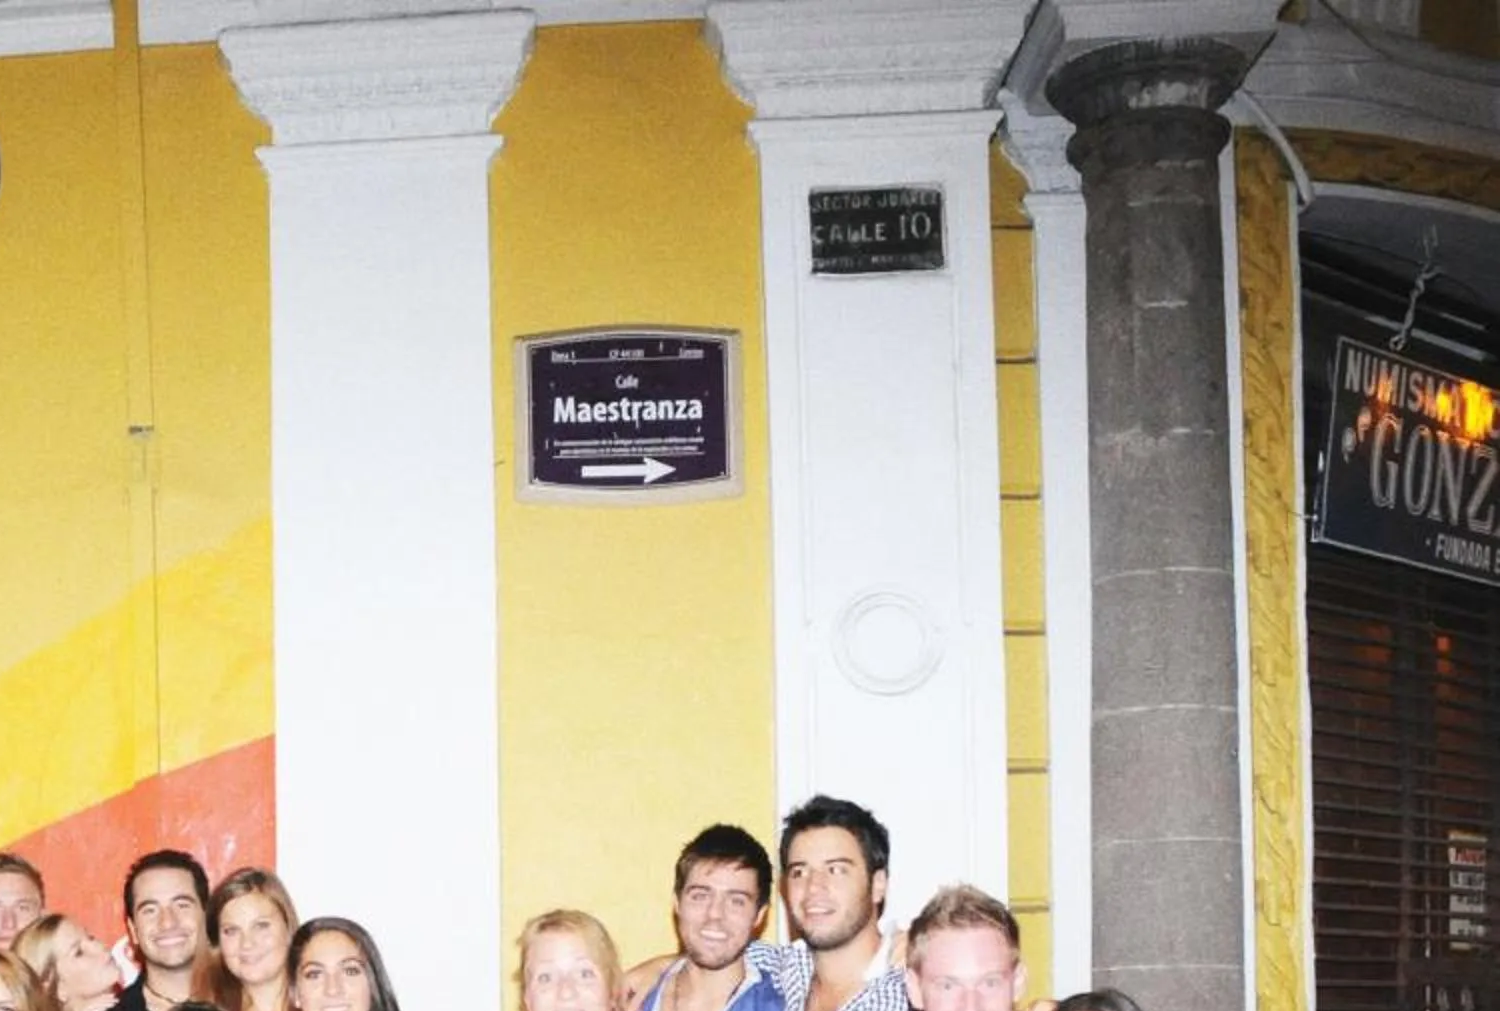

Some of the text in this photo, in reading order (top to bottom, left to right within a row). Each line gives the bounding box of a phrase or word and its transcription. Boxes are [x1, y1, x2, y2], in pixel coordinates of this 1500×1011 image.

[812, 222, 888, 245] CALLE
[615, 374, 639, 389] Calle
[553, 396, 704, 424] Maestranza
[1370, 411, 1500, 536] GONZ
